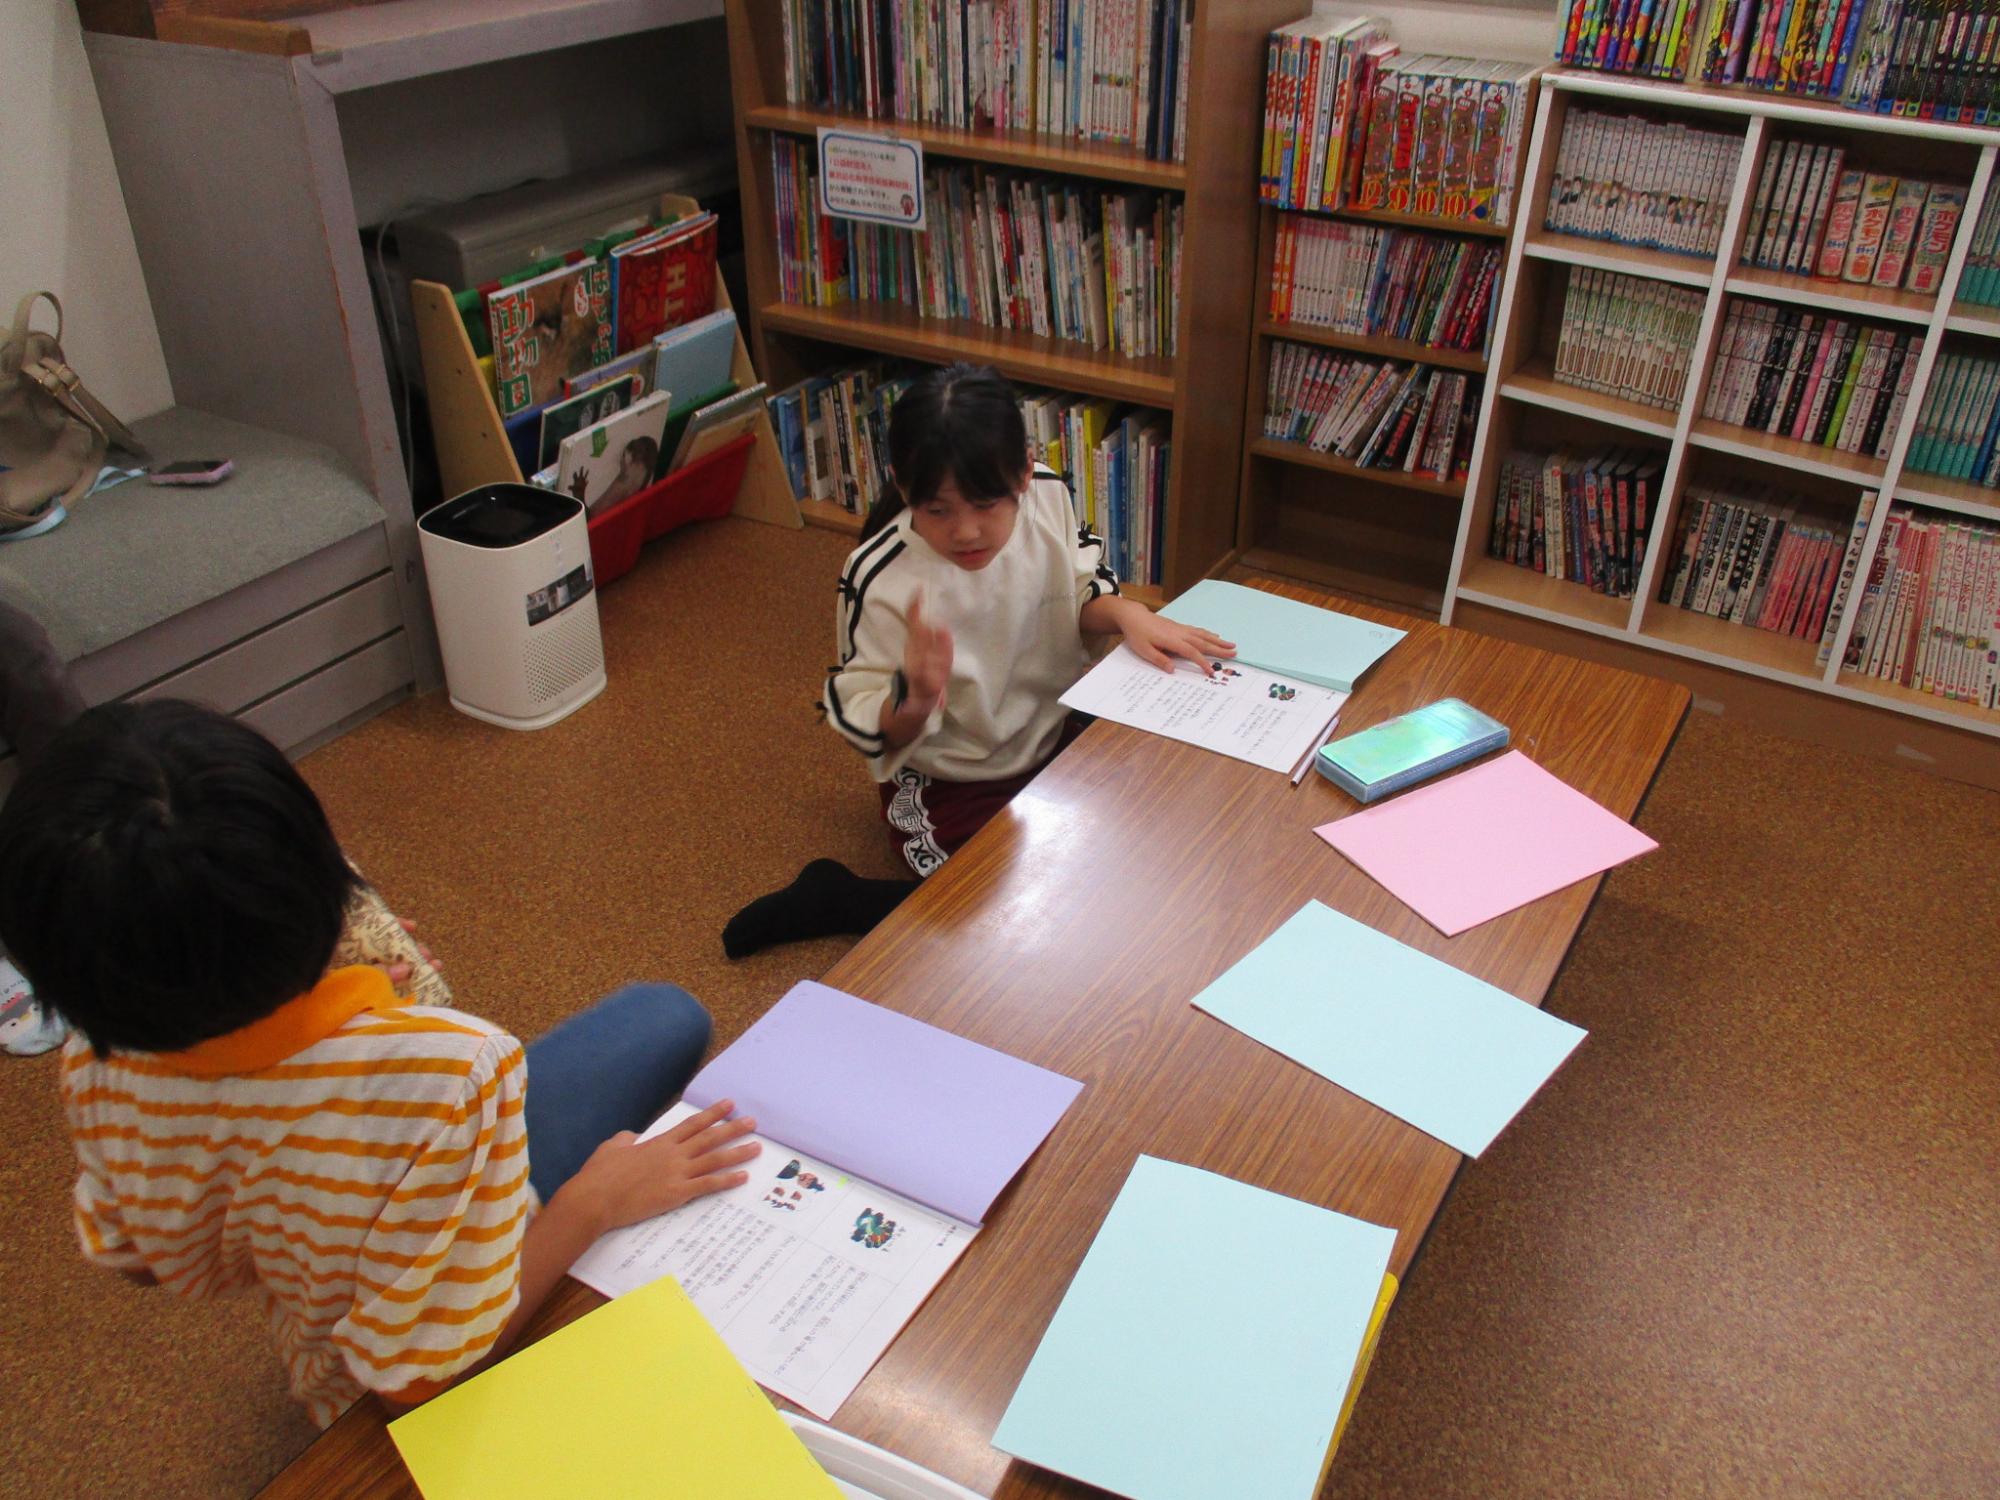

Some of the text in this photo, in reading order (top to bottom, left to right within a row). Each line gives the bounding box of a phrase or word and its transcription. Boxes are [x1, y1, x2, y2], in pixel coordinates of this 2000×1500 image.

[1859, 208, 1886, 247] ポケモン
[1929, 210, 1959, 254] ポケモン
